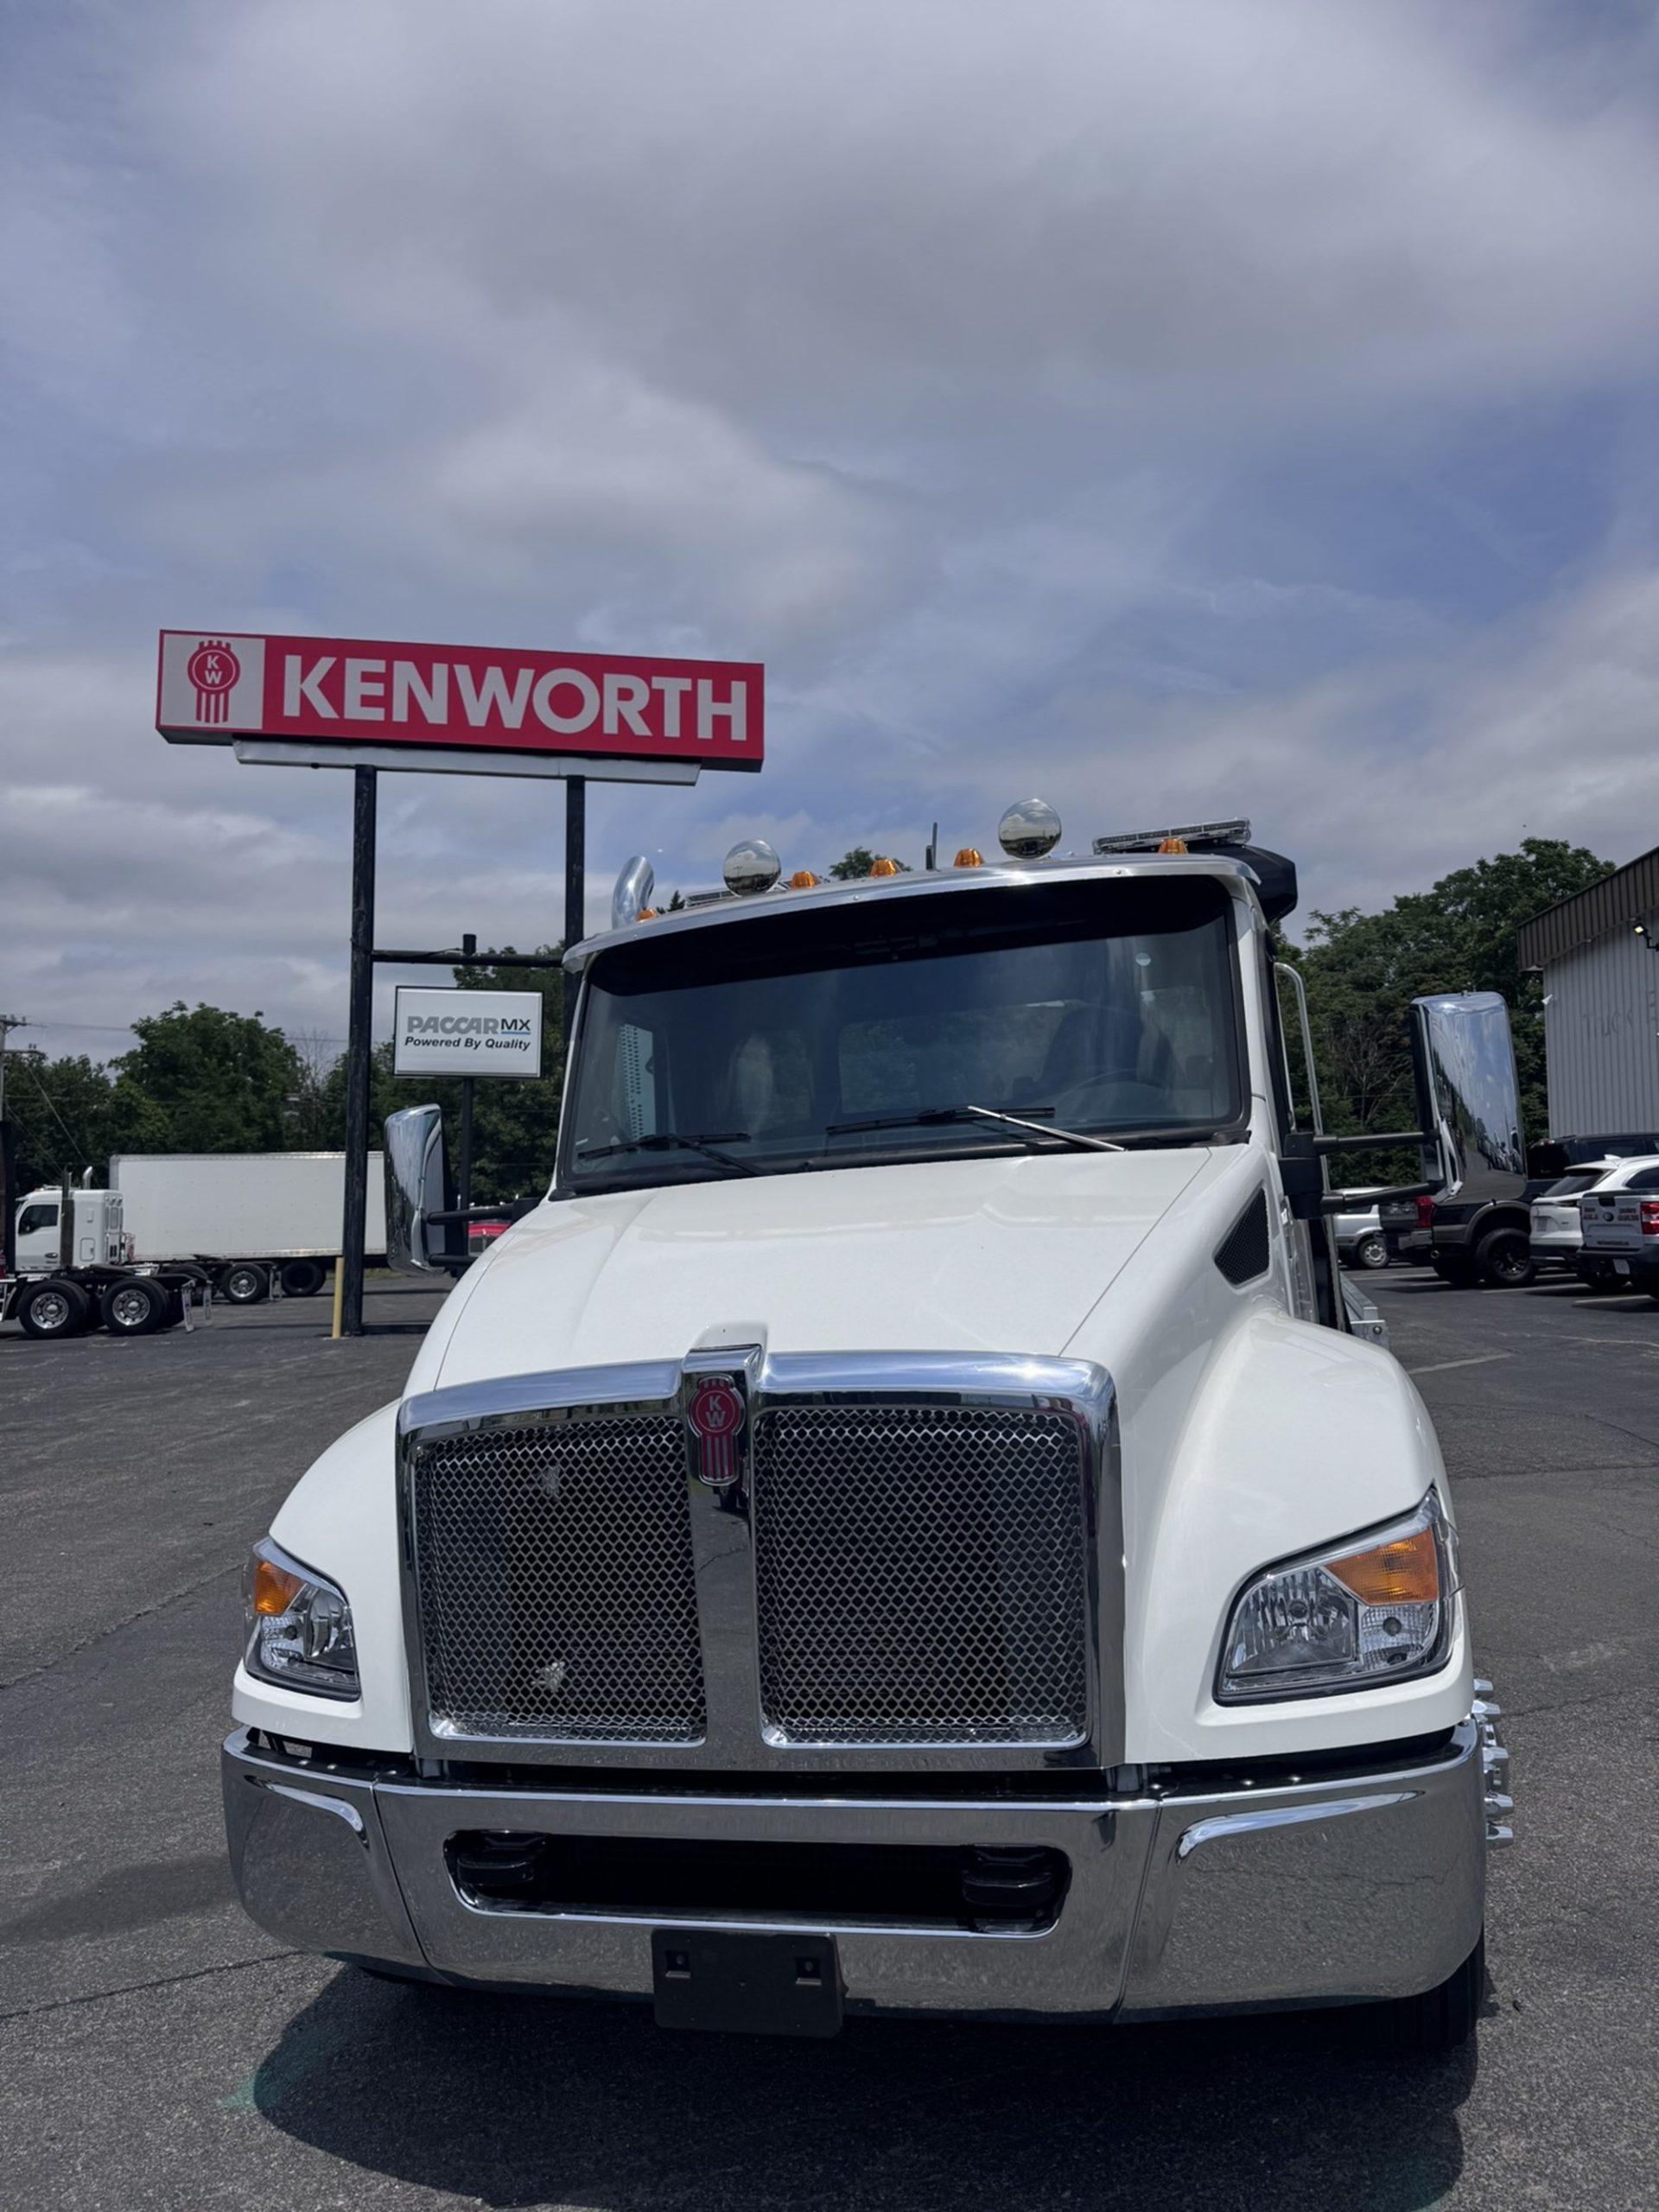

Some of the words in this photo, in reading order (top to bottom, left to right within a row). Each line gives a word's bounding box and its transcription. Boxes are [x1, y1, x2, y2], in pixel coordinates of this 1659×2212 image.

[207, 655, 220, 670] K
[204, 670, 223, 684] W
[283, 654, 747, 742] KENWORTH
[404, 1036, 461, 1048] Powered
[464, 1038, 482, 1051] By
[485, 1038, 531, 1052] Quality
